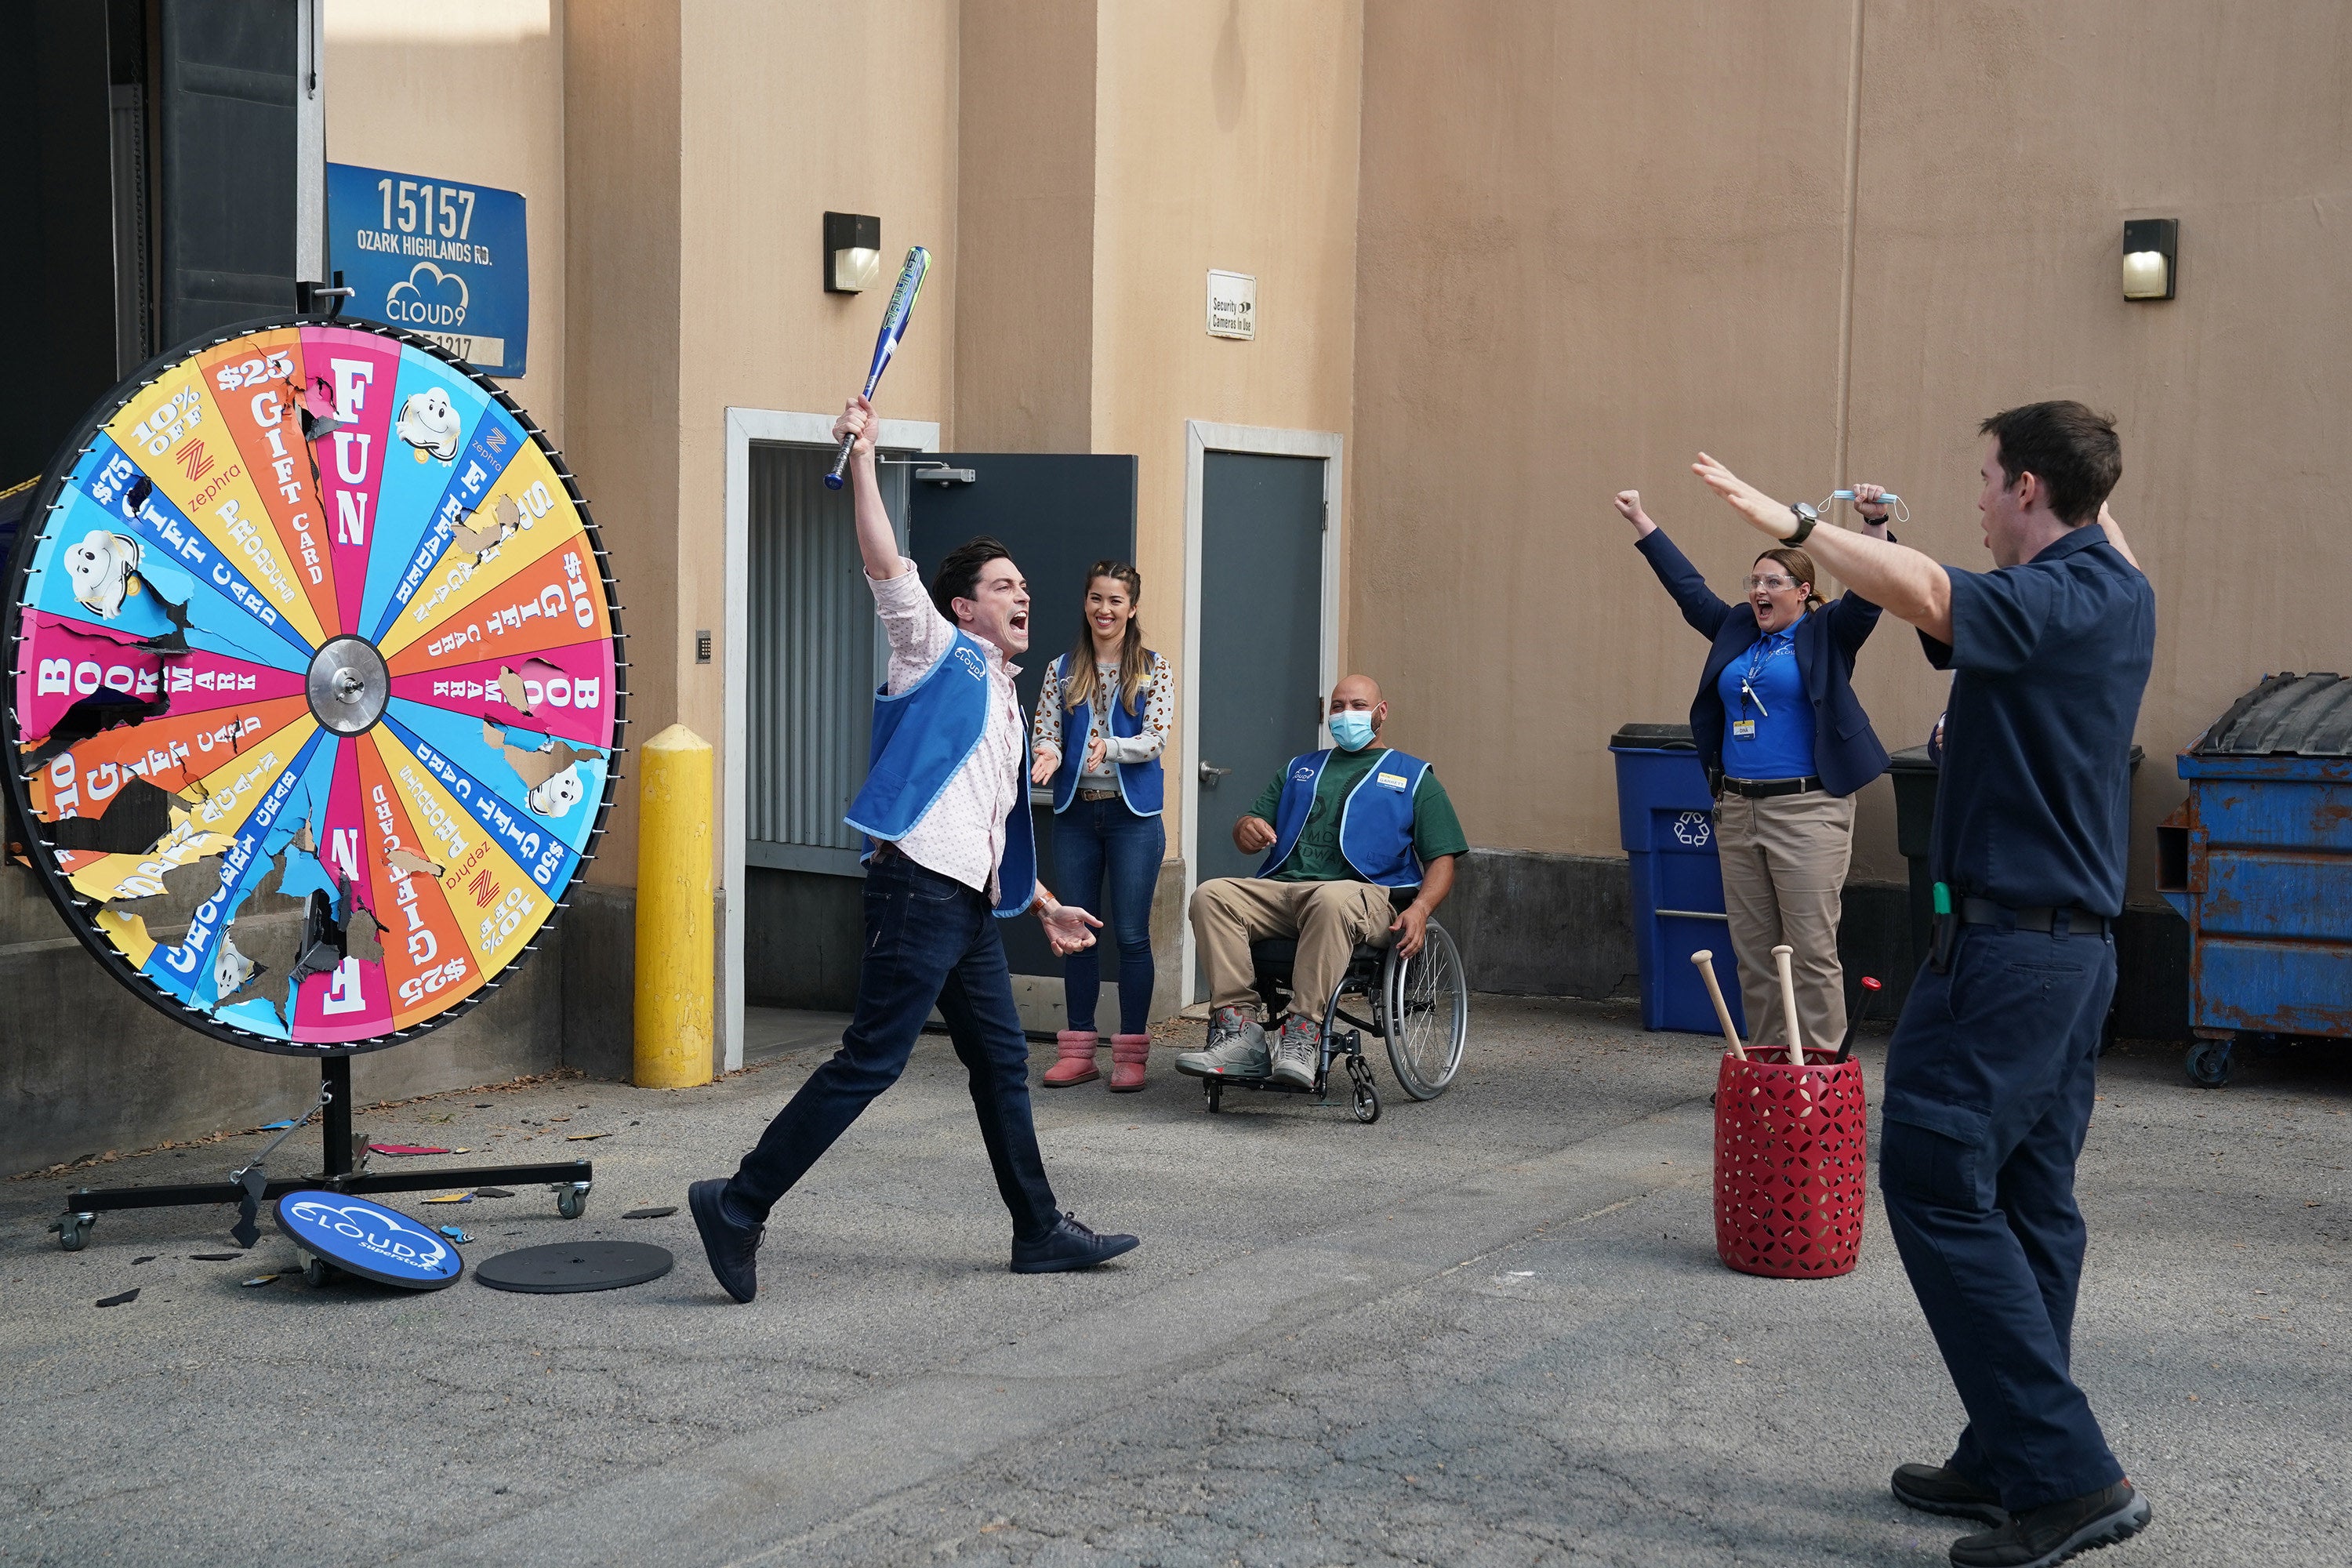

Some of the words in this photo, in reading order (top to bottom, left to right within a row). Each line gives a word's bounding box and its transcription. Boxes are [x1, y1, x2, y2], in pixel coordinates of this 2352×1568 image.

[377, 178, 476, 240] 15157
[357, 230, 399, 254] OZARK
[402, 236, 471, 263] HIGHLANDS
[386, 299, 467, 327] CLOUD9
[882, 249, 920, 329] RAWLINGS
[1213, 297, 1237, 315] Security
[1213, 314, 1236, 329] Cameras
[1237, 317, 1243, 330] In
[1243, 318, 1251, 332] Use
[216, 350, 295, 391] $25
[130, 384, 201, 447] 10%
[147, 405, 204, 456] OFF
[92, 452, 135, 506] $75
[330, 358, 374, 546] FUN
[472, 440, 503, 472] zephra
[187, 464, 241, 514] zephra
[251, 390, 303, 505] GIFT
[292, 512, 324, 586] CARD
[215, 499, 296, 604] PRODUCTS
[212, 562, 278, 626] CARD
[412, 561, 474, 623] AGAIN
[486, 584, 568, 636] GIFT
[563, 551, 595, 629] $10
[427, 624, 481, 657] CARD
[433, 676, 600, 710] BOOMARK
[86, 740, 191, 801] GIFT
[196, 716, 262, 753] CARD
[201, 751, 279, 824] AGAIN
[416, 742, 472, 800] CARD
[1379, 778, 1404, 787] GARRETT
[255, 771, 297, 827] GRAB
[372, 784, 401, 852] CARD
[397, 765, 470, 859] PRODUCTS
[475, 797, 541, 860] GIFT
[446, 841, 491, 890] zephra
[533, 840, 565, 886] $50
[323, 828, 366, 1016] FN
[389, 861, 438, 967] GIFT
[481, 887, 524, 940] OFF
[481, 893, 536, 956] 10%
[397, 956, 467, 1007] $25
[290, 1205, 441, 1266] CLOUD9
